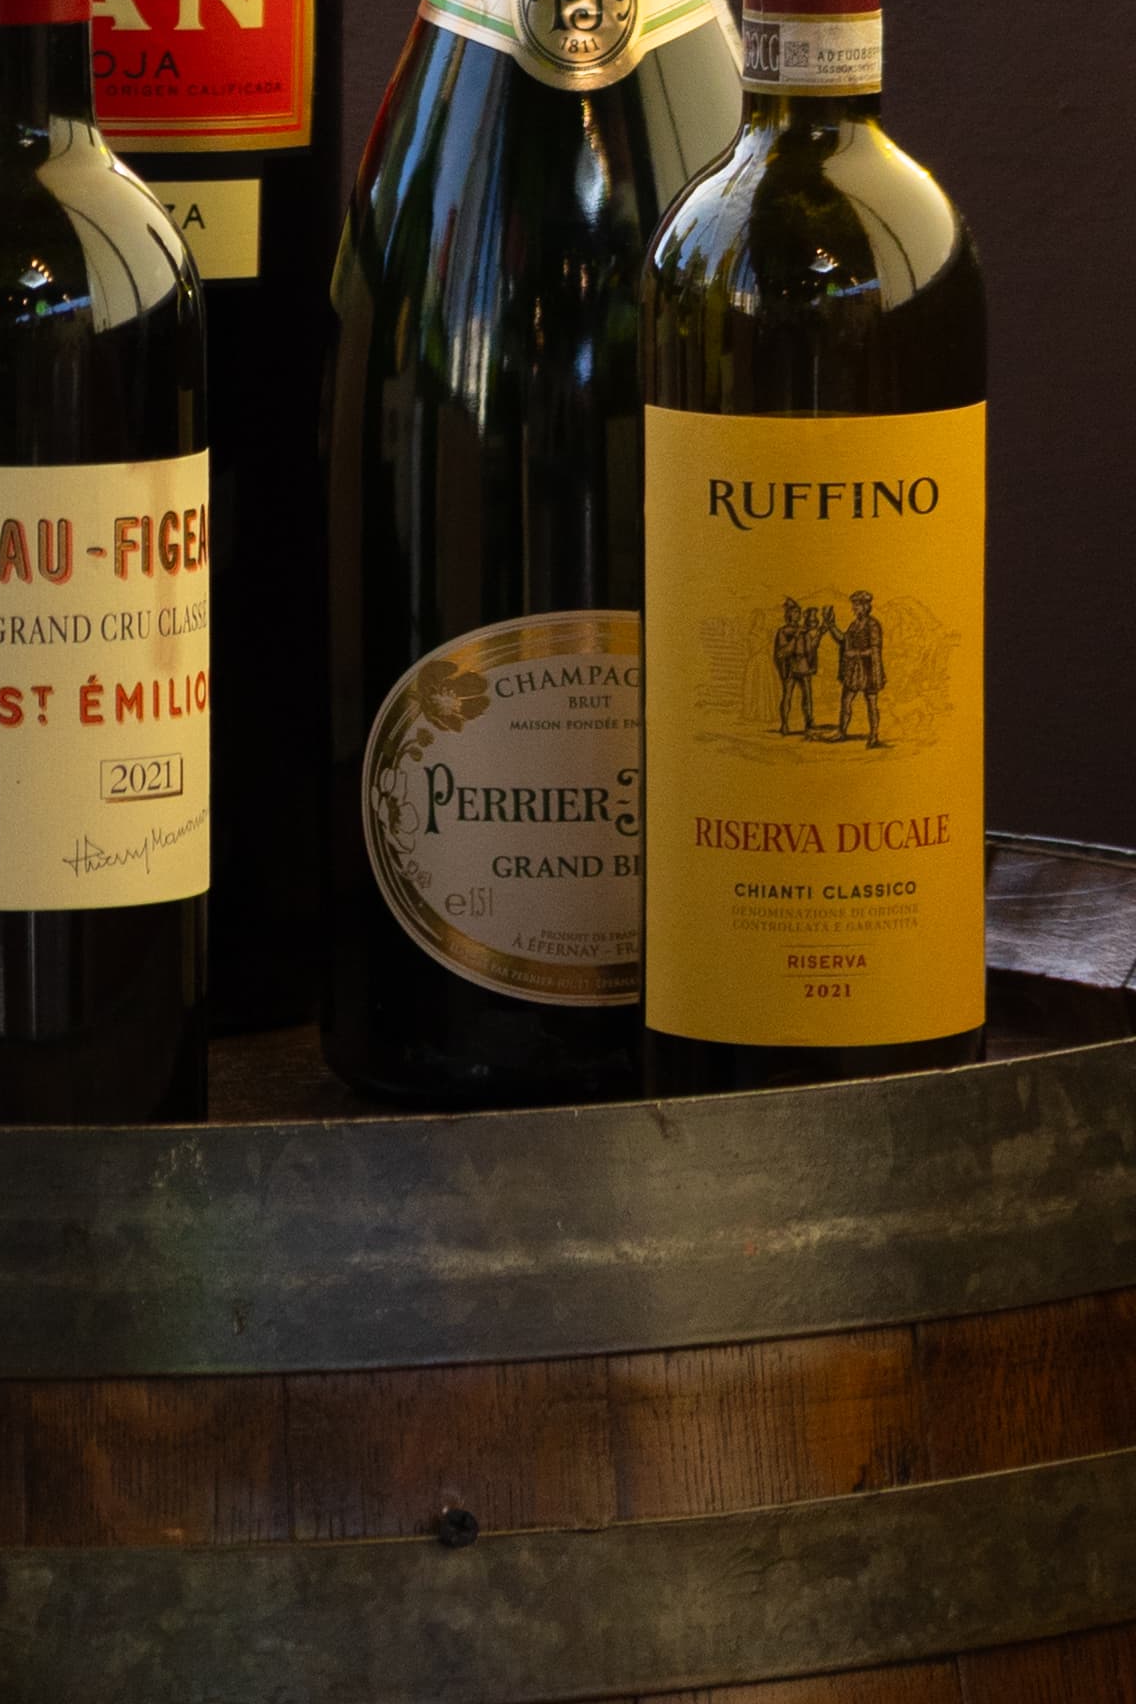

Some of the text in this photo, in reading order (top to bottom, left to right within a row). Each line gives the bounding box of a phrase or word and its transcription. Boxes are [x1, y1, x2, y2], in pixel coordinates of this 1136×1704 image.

[559, 37, 601, 54] 1811
[106, 83, 179, 97] ORIGEN
[707, 476, 940, 531] RUFFINO
[100, 609, 151, 642] CRU
[568, 695, 612, 709] BRUT
[509, 719, 561, 731] MAISON
[110, 760, 173, 796] 2021
[694, 813, 952, 855] RISERVA DUCALE
[492, 854, 604, 879] GRAND
[733, 880, 918, 901] CHIANTI CLASSICO
[786, 953, 867, 972] RISERVA
[804, 982, 852, 999] 2021
